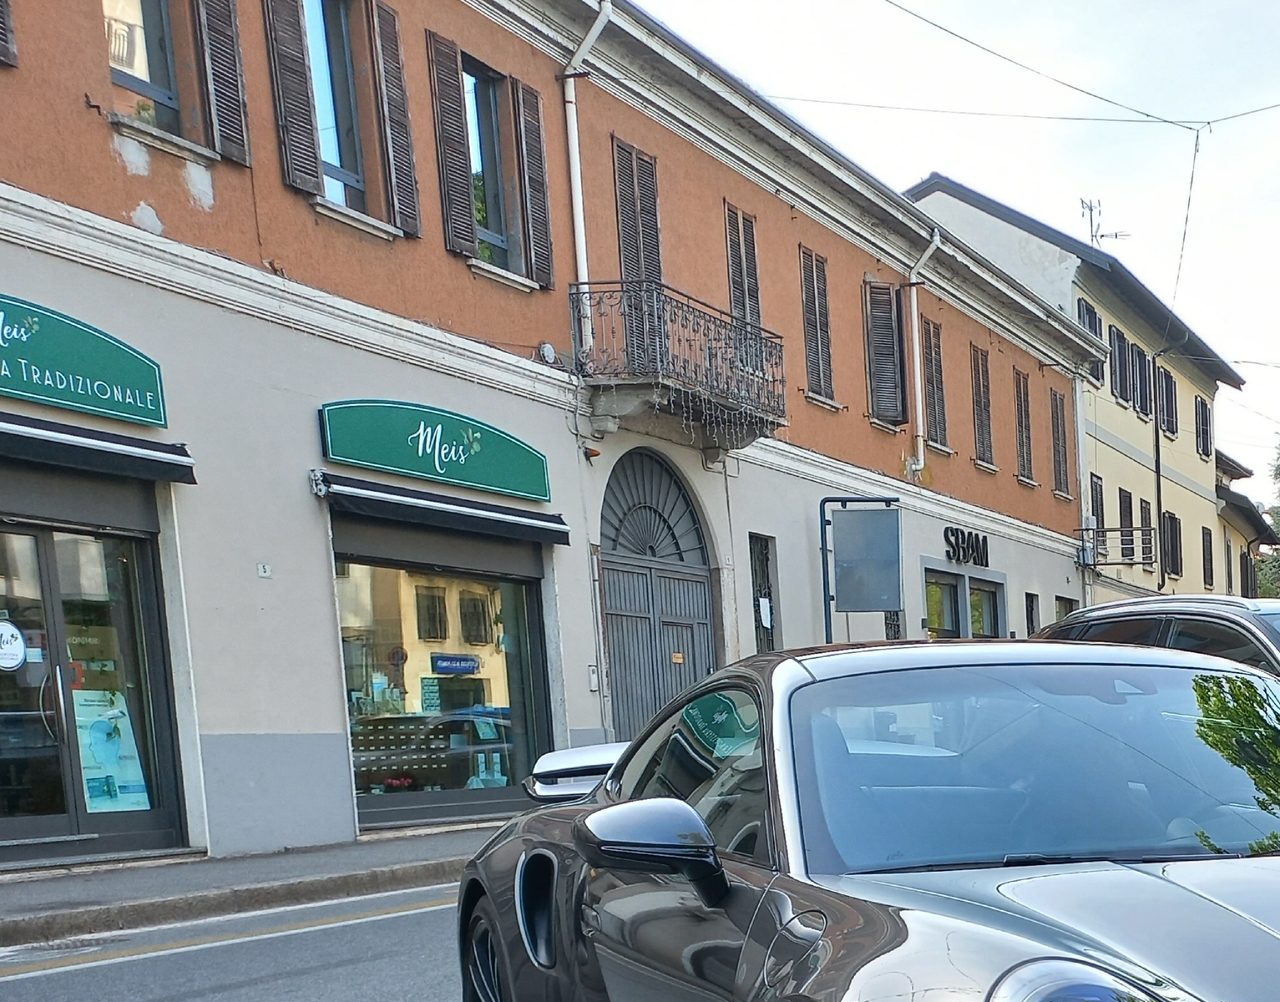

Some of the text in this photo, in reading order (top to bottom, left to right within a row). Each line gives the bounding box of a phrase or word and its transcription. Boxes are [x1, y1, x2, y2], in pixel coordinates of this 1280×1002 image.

[17, 358, 156, 410] TRADIZIONALE
[407, 420, 469, 473] Meis
[943, 526, 989, 568] SBAM
